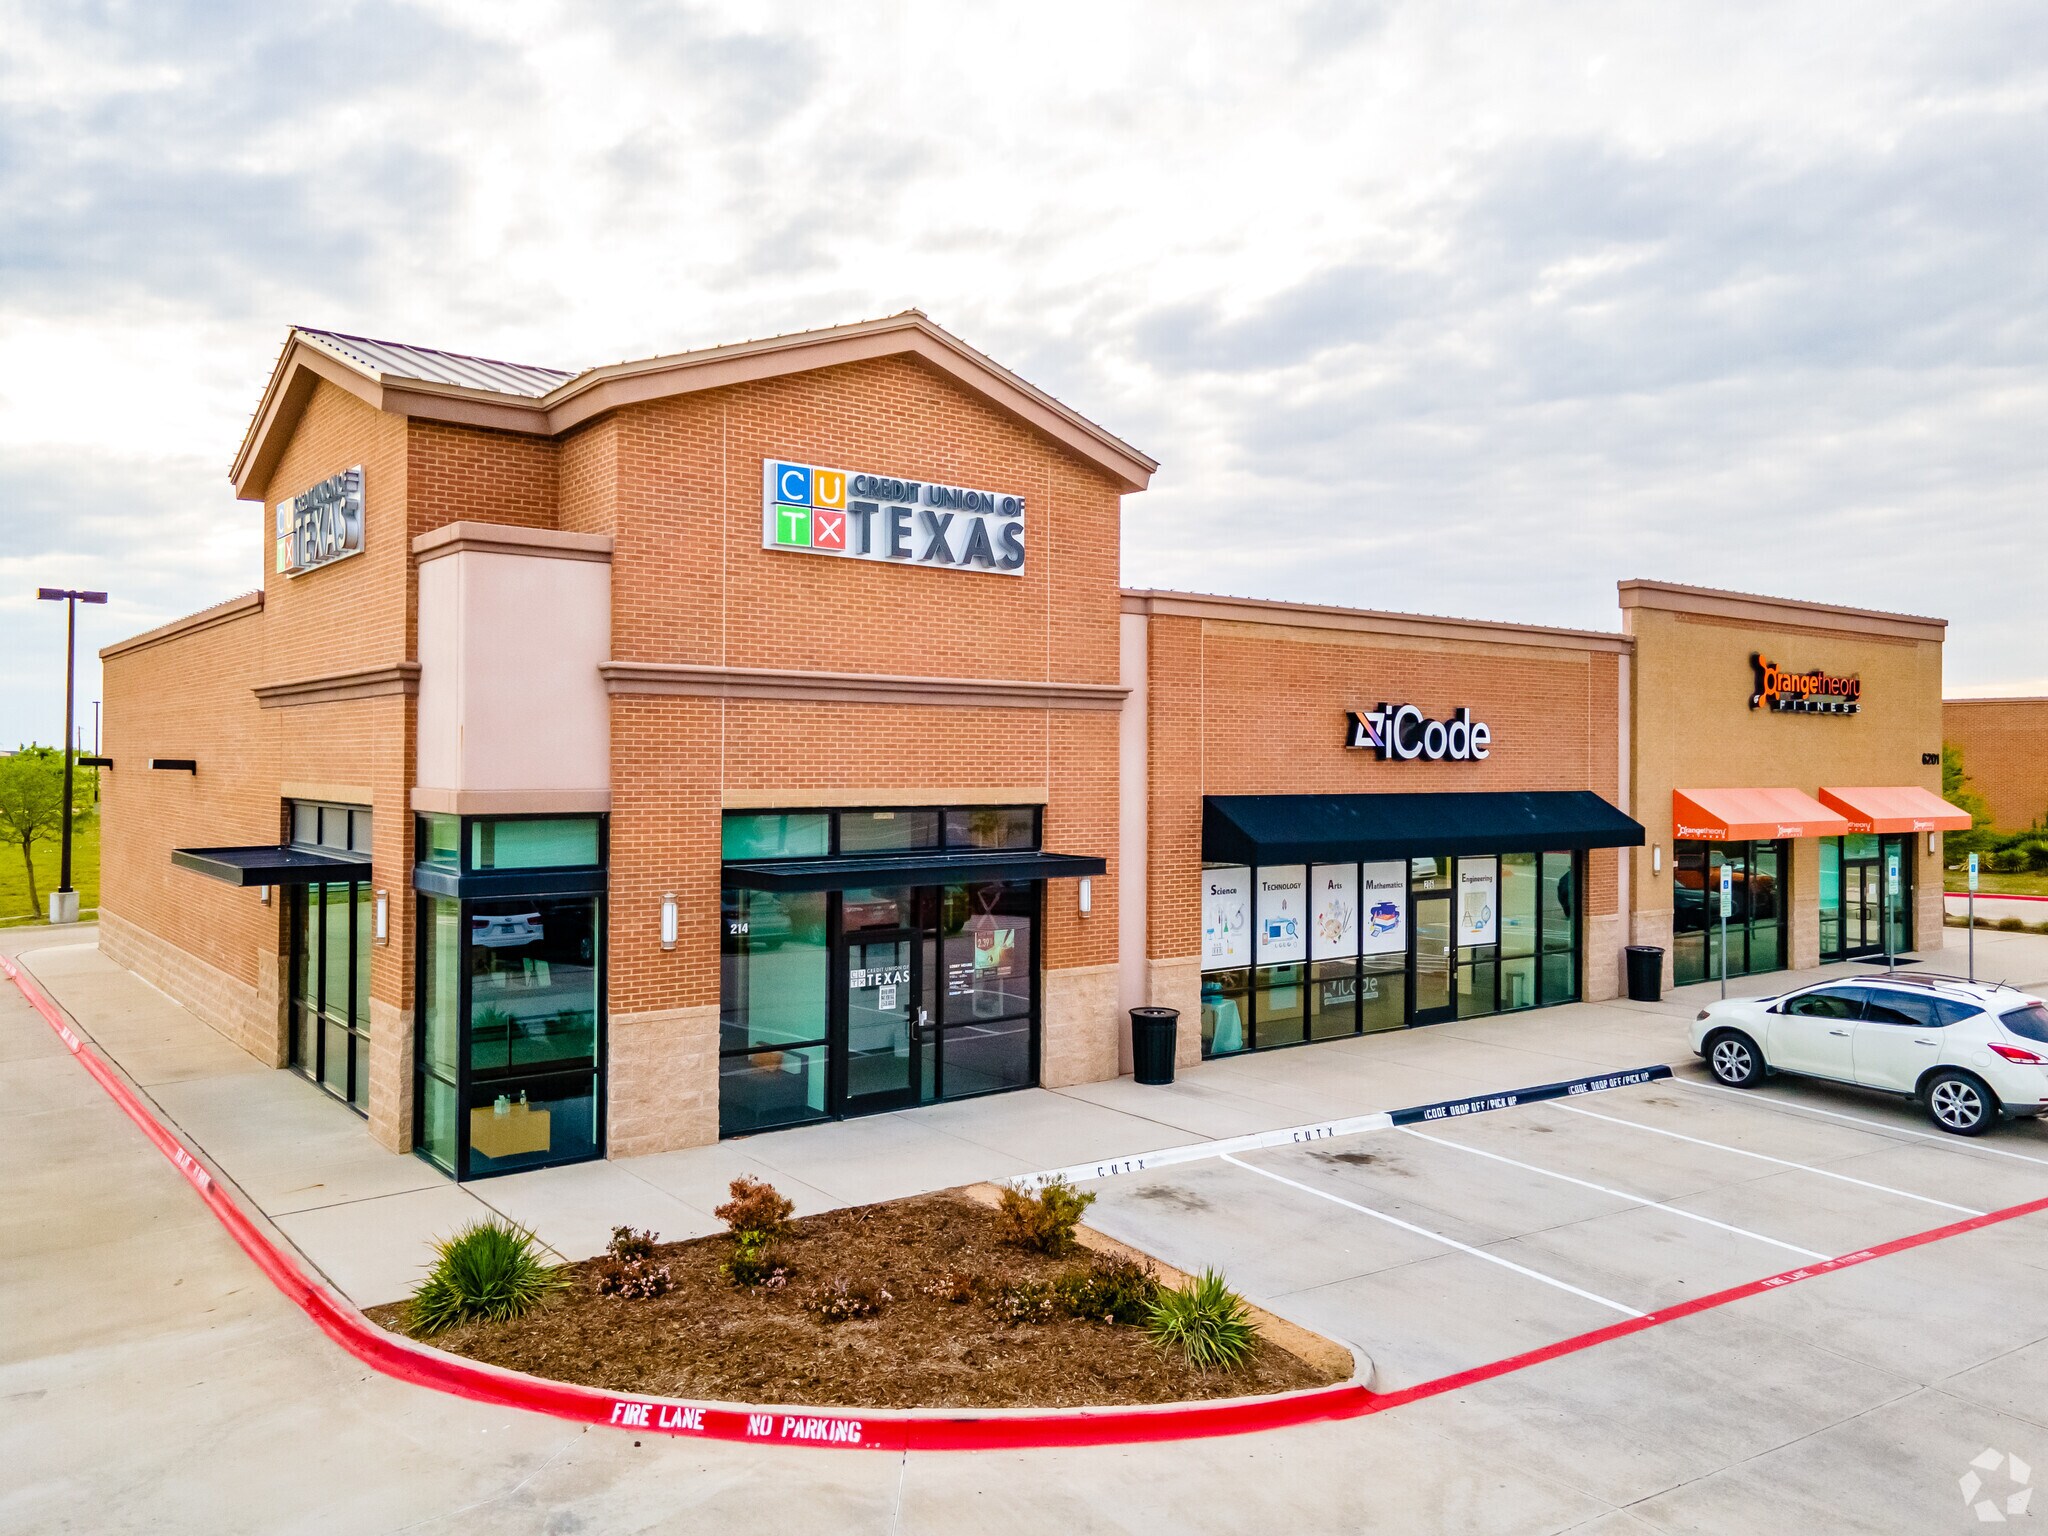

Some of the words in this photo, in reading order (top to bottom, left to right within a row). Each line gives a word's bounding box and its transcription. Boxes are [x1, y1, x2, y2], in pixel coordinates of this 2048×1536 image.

[849, 475, 921, 503] CREDIT
[927, 485, 994, 514] UNION
[999, 496, 1026, 517] OF
[295, 496, 347, 567] TEXAS
[850, 501, 1026, 570] TEXAS
[1780, 700, 1860, 712] FITNESS
[1385, 704, 1490, 759] iCode
[1922, 753, 1939, 765] 6201
[1328, 879, 1343, 890] Arts
[1461, 873, 1493, 884] Engineering
[1211, 884, 1237, 896] Science
[1262, 881, 1301, 892] TECHNOLOGY
[1365, 880, 1403, 890] Mathematics
[730, 923, 748, 935] 214
[867, 970, 910, 987] TEXAS
[1590, 1079, 1608, 1091] DROP
[1450, 1103, 1470, 1116] DROP
[1507, 1096, 1518, 1107] UP
[610, 1402, 653, 1427] FIRE
[658, 1406, 706, 1431] LANE
[747, 1413, 773, 1437] NO
[781, 1416, 862, 1444] PARKING
